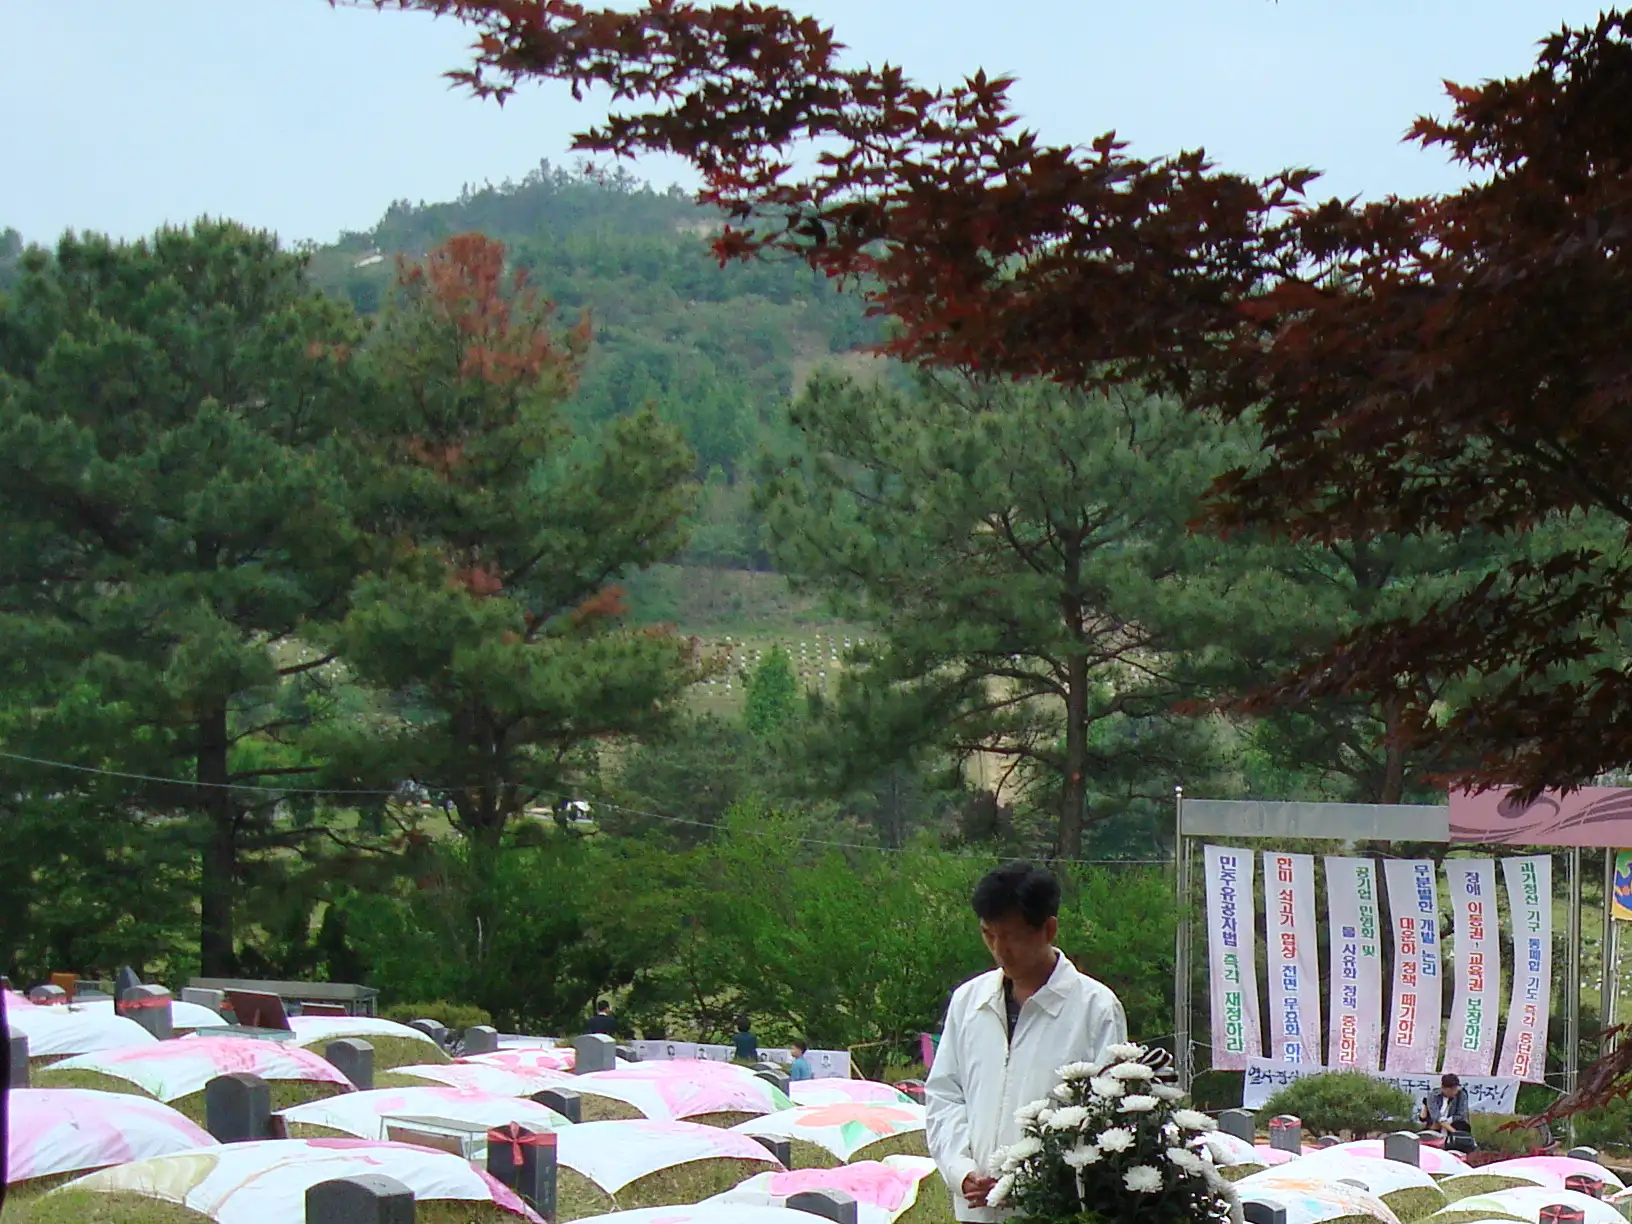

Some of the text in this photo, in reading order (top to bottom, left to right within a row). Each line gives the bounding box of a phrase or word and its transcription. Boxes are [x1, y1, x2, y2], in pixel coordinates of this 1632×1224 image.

[1276, 857, 1293, 884] 한미
[1464, 871, 1482, 897] 장애
[1219, 855, 1238, 948] 민주유공자법
[1279, 889, 1295, 928] 쇠고기
[1355, 866, 1376, 957] 공기업 민영화 및
[1413, 864, 1437, 977] 무분별한 개발 논리
[1526, 910, 1541, 933] 기구
[1280, 932, 1297, 960] 협상
[1342, 943, 1357, 979] 사유화
[1223, 953, 1240, 984] 즉각
[1282, 965, 1298, 991] 전면
[1397, 917, 1417, 1047] 대운하 정책 폐기하라
[1468, 952, 1484, 992] 교육권
[1525, 976, 1540, 1000] 기도
[1342, 985, 1357, 1009] 정책
[1283, 997, 1301, 1037] 무효화
[1463, 998, 1482, 1052] 보장하라
[1340, 1015, 1357, 1063] 중단하라
[1512, 1032, 1533, 1078] 중단하라
